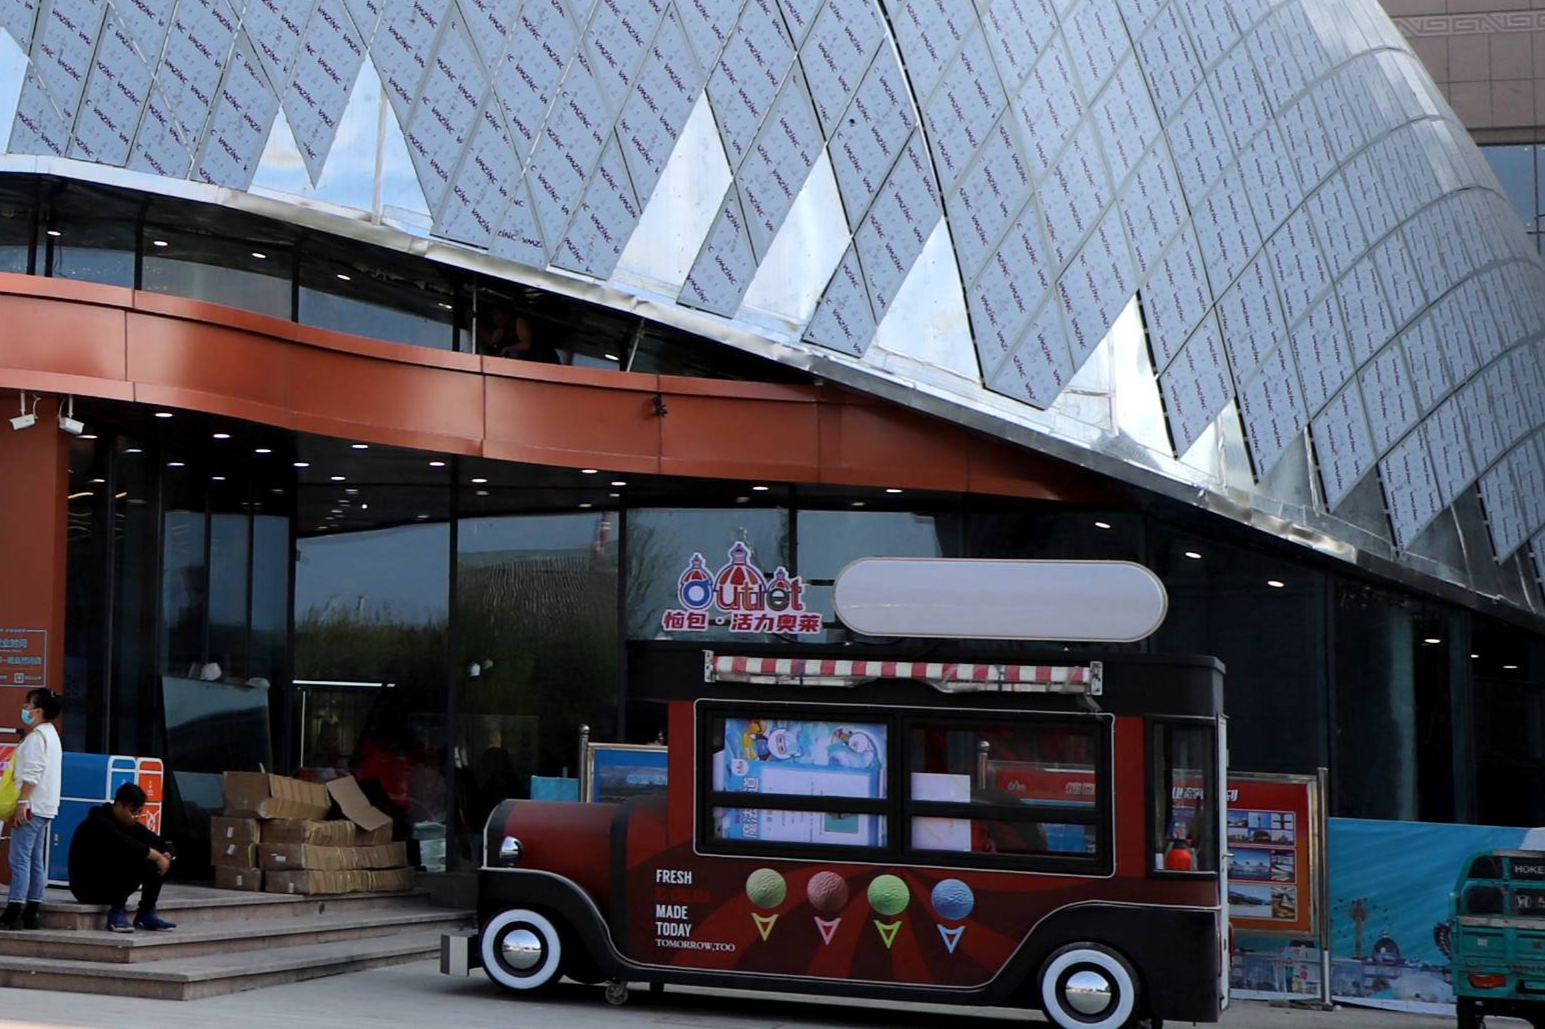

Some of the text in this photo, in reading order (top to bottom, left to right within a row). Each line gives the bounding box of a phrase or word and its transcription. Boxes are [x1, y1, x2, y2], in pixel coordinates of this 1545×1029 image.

[656, 869, 692, 884] FRESH
[656, 904, 688, 919] MADE
[656, 921, 692, 937] TODAY
